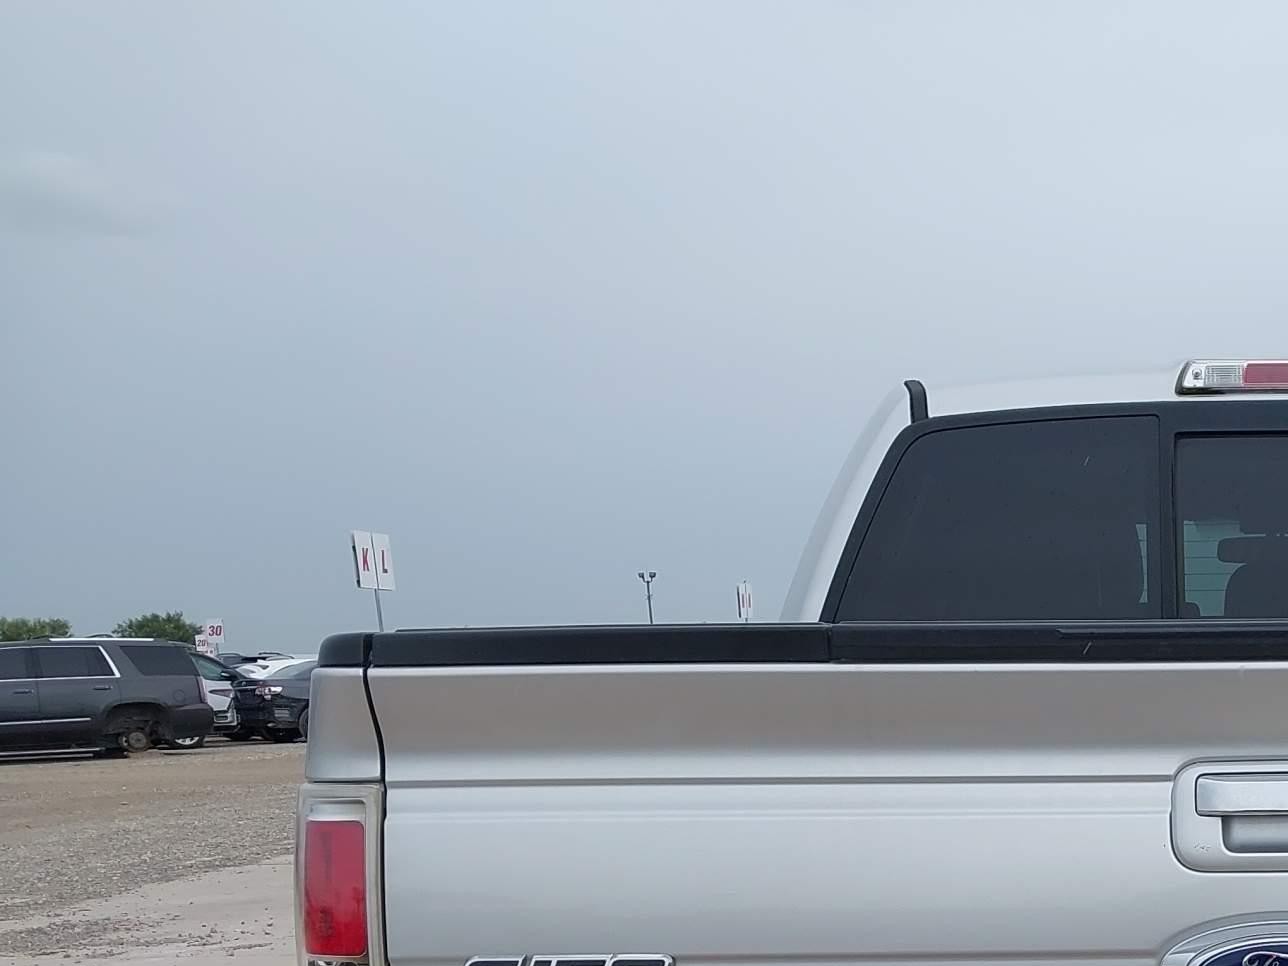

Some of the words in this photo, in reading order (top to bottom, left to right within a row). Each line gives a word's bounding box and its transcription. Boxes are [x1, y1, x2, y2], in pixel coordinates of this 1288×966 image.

[361, 547, 370, 572] K
[381, 549, 389, 574] L
[208, 625, 222, 637] 30
